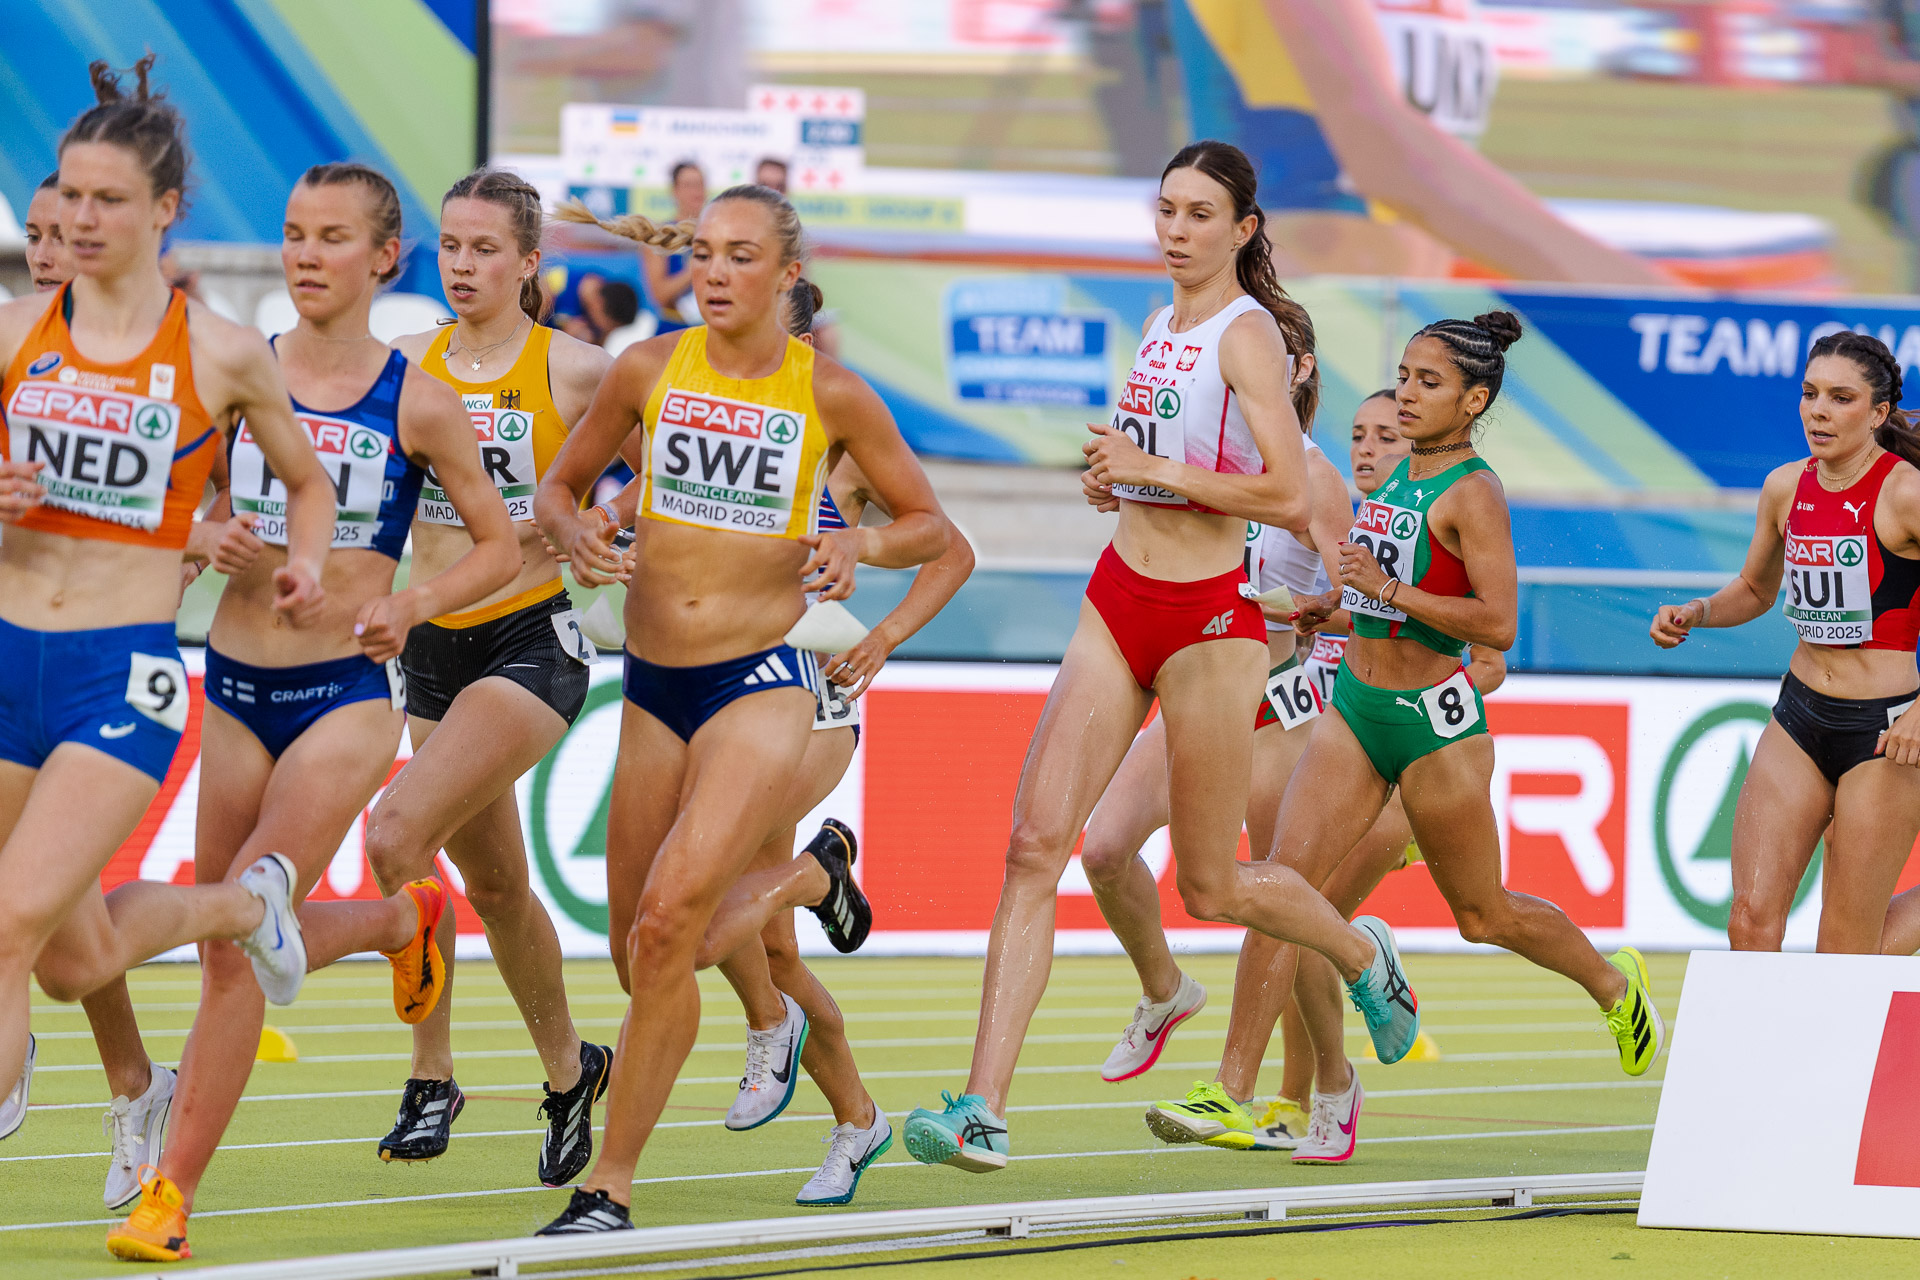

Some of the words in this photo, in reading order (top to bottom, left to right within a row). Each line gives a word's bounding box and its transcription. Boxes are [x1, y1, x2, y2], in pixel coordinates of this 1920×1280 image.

[970, 316, 1084, 354] TEAM
[1630, 313, 1800, 378] TEAM
[15, 389, 130, 430] SPAR
[463, 400, 492, 409] WGV
[664, 397, 761, 436] SPAR
[28, 425, 148, 487] NED
[665, 432, 783, 492] SWE
[682, 482, 707, 498] RUN
[1802, 502, 1815, 511] UBS
[662, 494, 727, 521] MADRID
[732, 510, 776, 528] 2025
[1790, 568, 1845, 609] SUI
[567, 620, 590, 659] 2
[1827, 625, 1864, 640] 2025
[148, 668, 176, 712] 9
[270, 686, 325, 703] CRAFT
[1271, 675, 1313, 721] 16
[1437, 686, 1465, 726] 8
